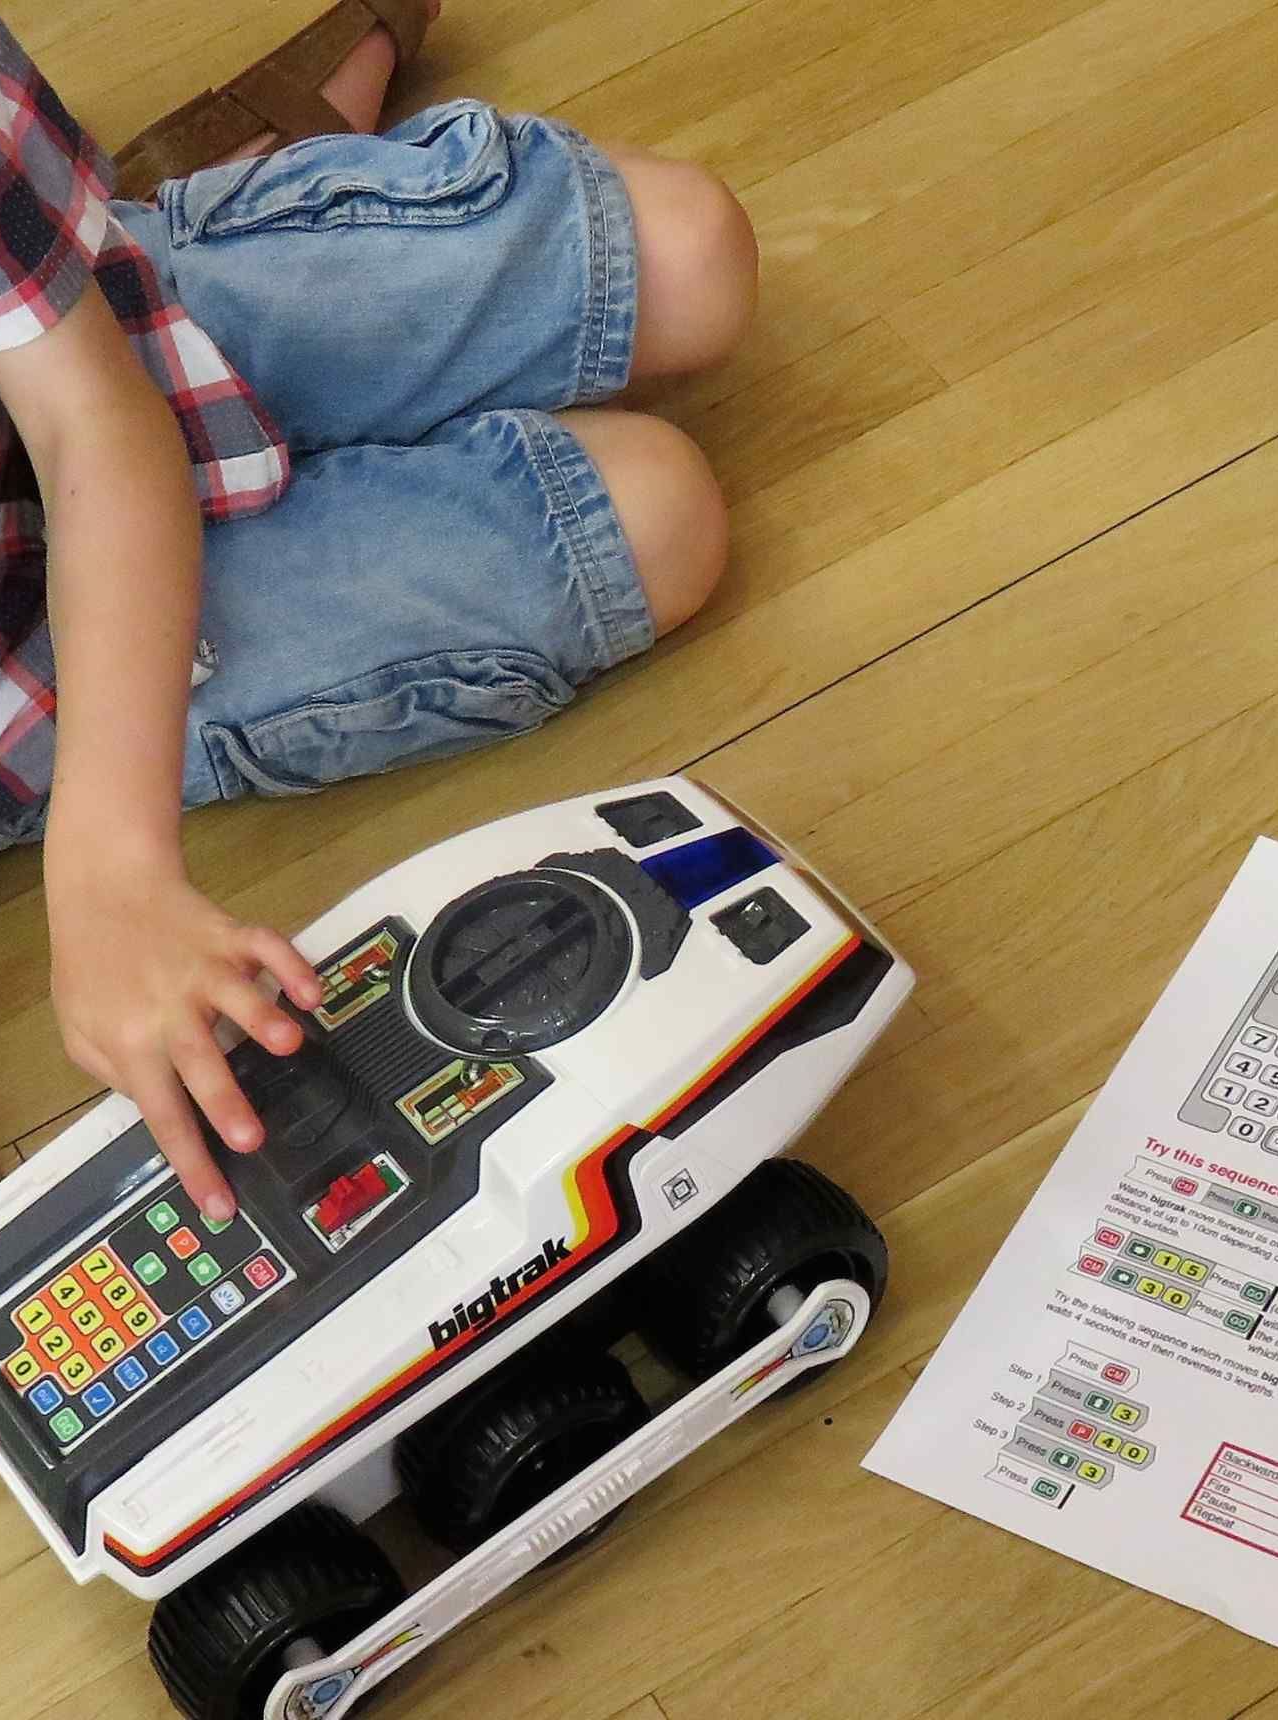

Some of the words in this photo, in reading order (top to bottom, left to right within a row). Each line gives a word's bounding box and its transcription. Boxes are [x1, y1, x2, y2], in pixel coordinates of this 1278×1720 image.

[1253, 1033, 1268, 1045] 7
[1236, 1061, 1251, 1073] 4
[1224, 1086, 1233, 1098] 1
[1253, 1097, 1270, 1111] 2
[1239, 1123, 1253, 1136] 0
[1145, 1137, 1171, 1157] Try
[1173, 1149, 1204, 1168] this
[1163, 1256, 1171, 1266] 1
[1186, 1265, 1200, 1276] 5
[89, 1258, 107, 1273] 7
[110, 1285, 127, 1301] 8
[131, 1311, 148, 1327] 9
[427, 1234, 573, 1350] bigtrak
[1143, 1283, 1156, 1294] 3
[1170, 1293, 1183, 1304] 0
[59, 1286, 75, 1300] 4
[78, 1310, 96, 1326] 5
[99, 1337, 116, 1353] 6
[28, 1310, 44, 1325] 1
[46, 1336, 63, 1352] 2
[68, 1362, 85, 1378] 3
[15, 1361, 31, 1376] 0
[1119, 1409, 1132, 1420] 3
[1016, 1402, 1026, 1411] 2
[1102, 1438, 1114, 1448] 4
[1128, 1447, 1140, 1459] 0
[1000, 1430, 1008, 1439] 3
[1085, 1466, 1097, 1478] 3
